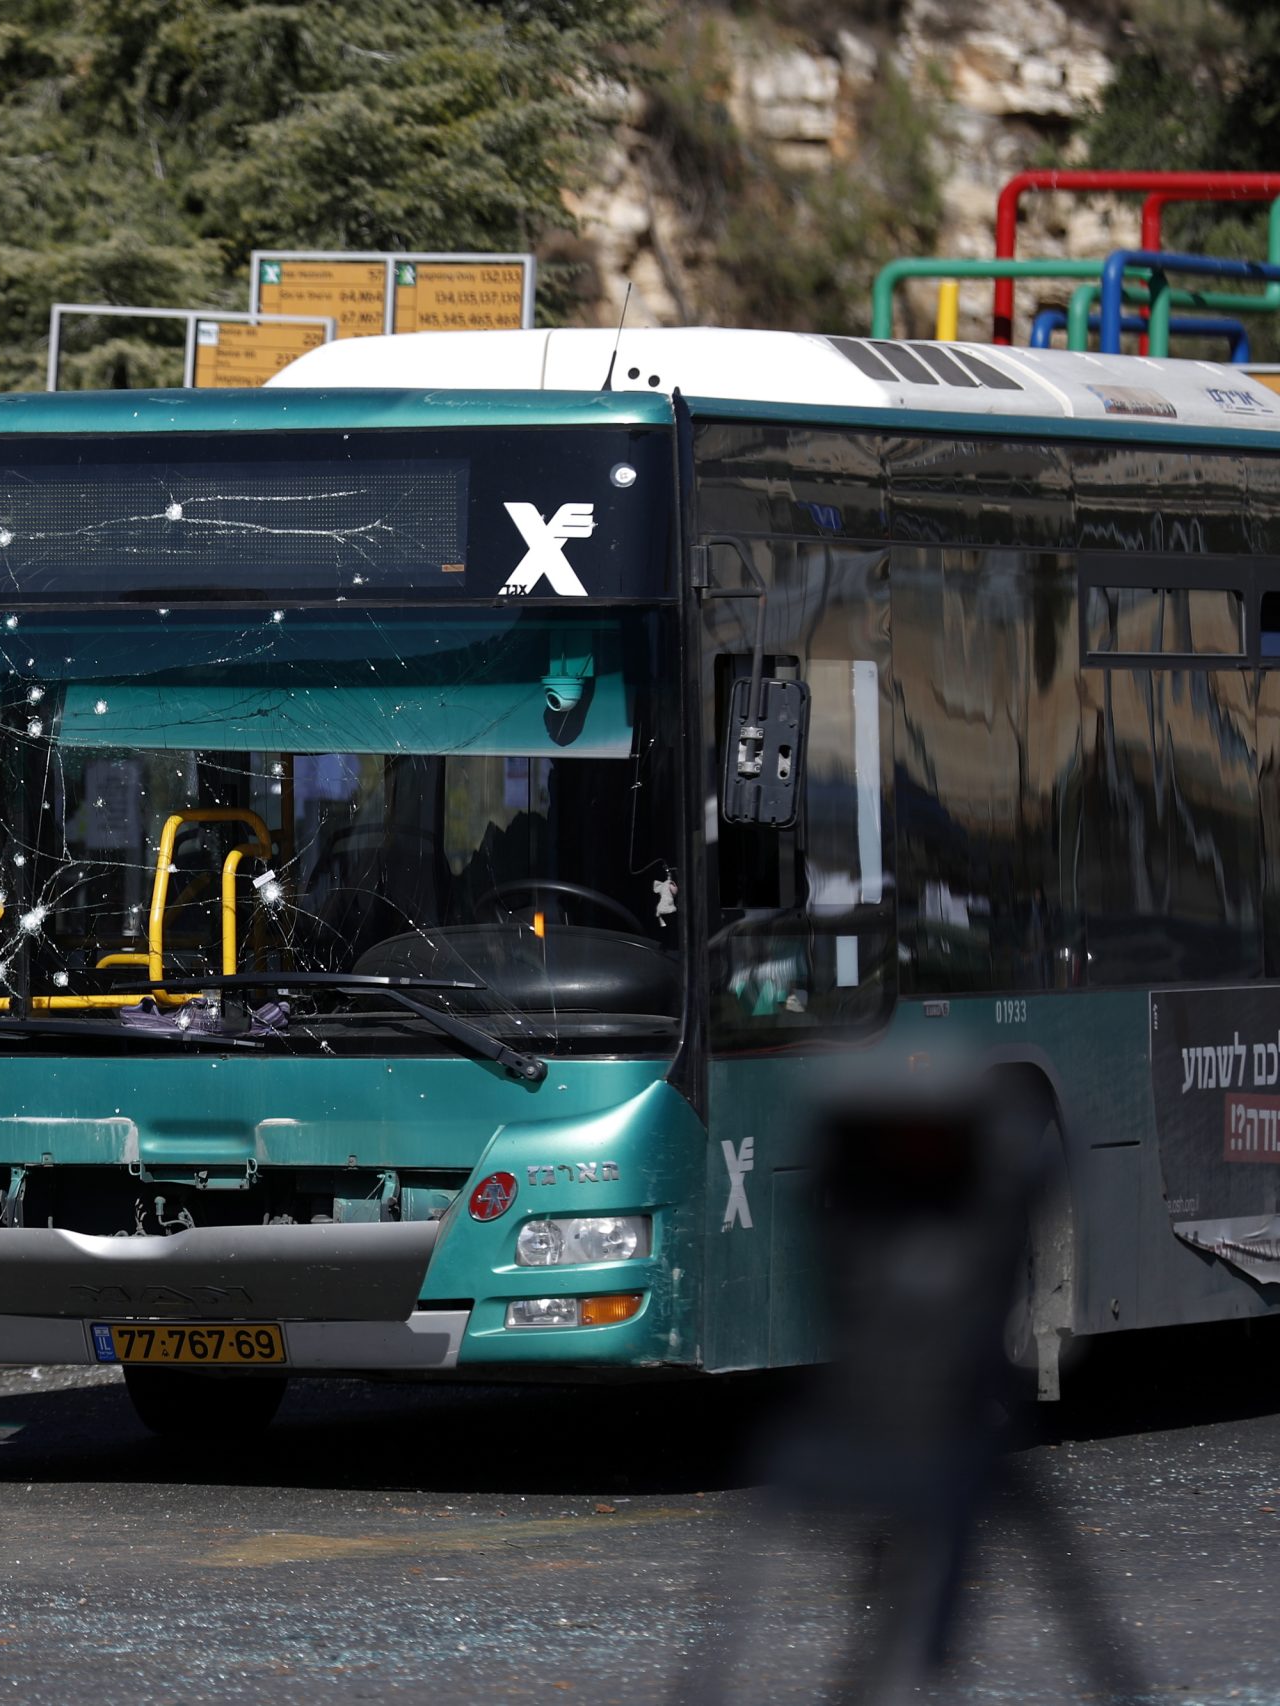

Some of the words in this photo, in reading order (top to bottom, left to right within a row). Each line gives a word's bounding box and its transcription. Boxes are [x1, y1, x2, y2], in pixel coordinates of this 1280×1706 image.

[995, 1000, 1027, 1023] 01933
[1182, 1031, 1247, 1094] לשמוע
[1231, 1104, 1280, 1152] ודה?!
[527, 1161, 620, 1186] הארגז
